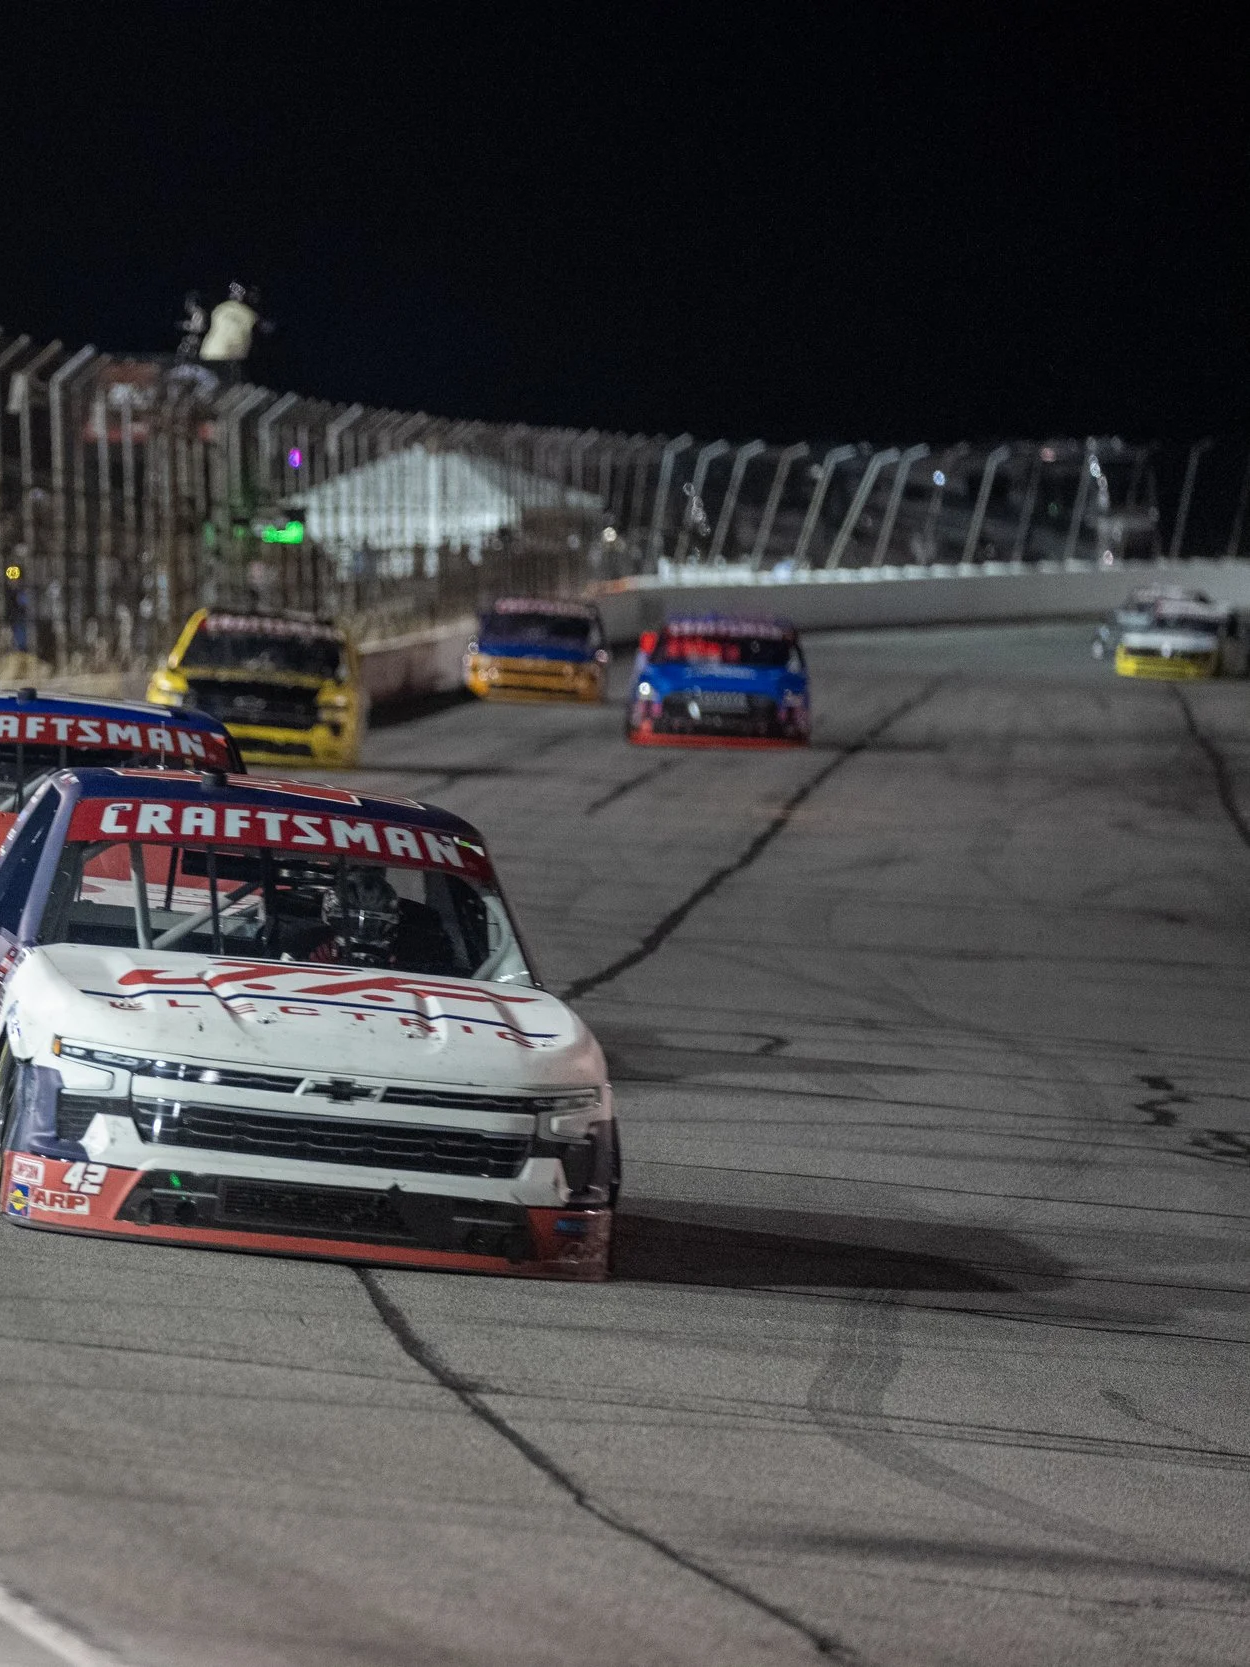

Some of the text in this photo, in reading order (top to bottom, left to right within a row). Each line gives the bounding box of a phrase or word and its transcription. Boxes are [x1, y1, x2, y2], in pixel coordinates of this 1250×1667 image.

[100, 802, 465, 869] CRAFTSMAN
[109, 1000, 538, 1049] ELECTRIC
[62, 1161, 109, 1195] 42
[32, 1188, 87, 1210] ARP
